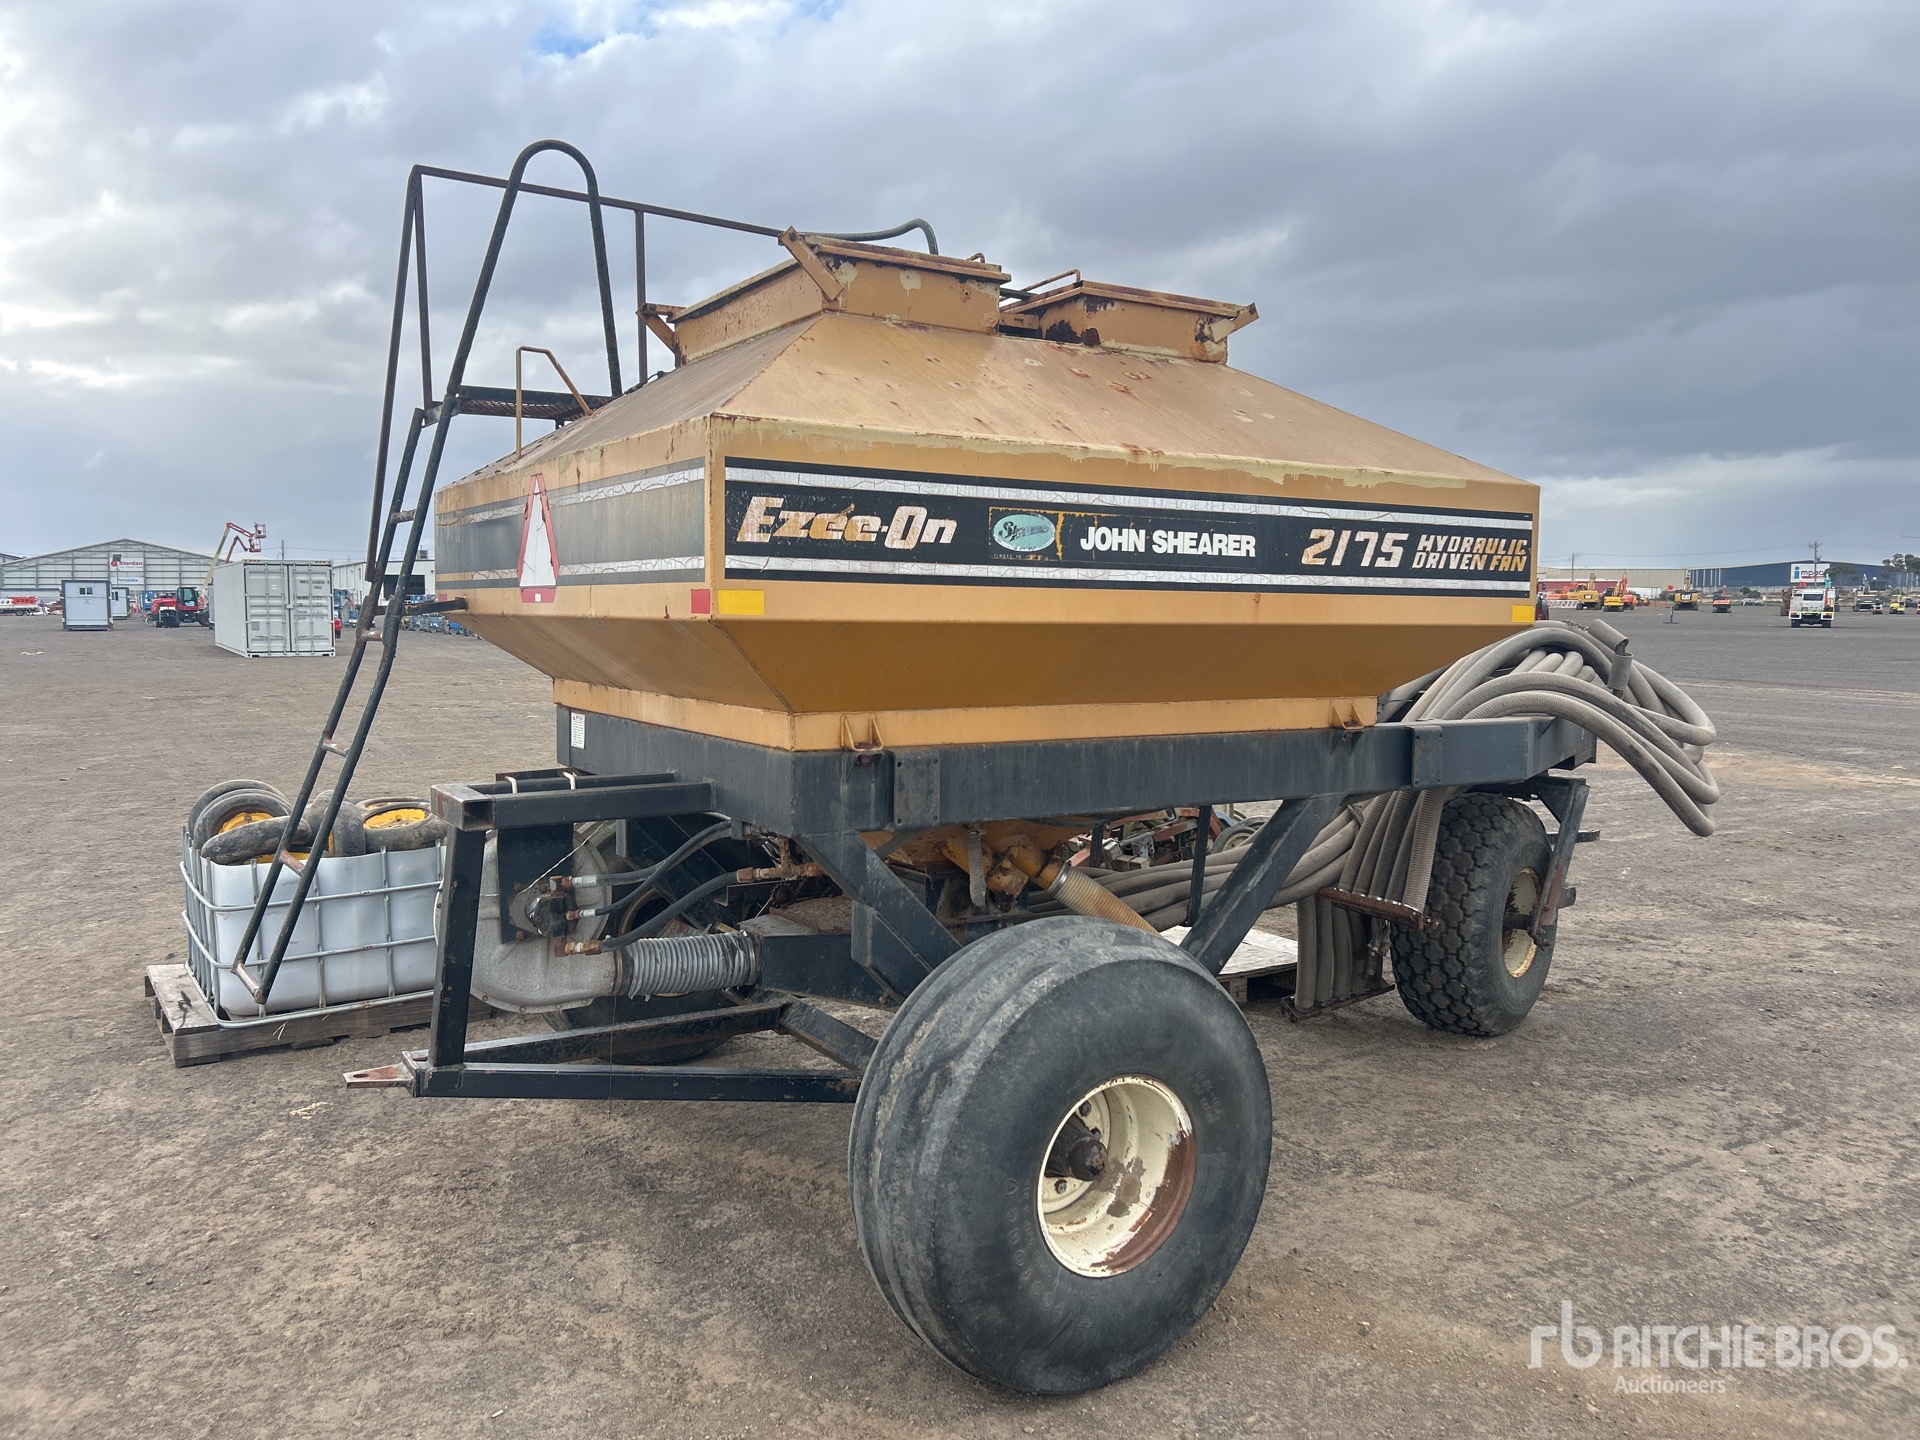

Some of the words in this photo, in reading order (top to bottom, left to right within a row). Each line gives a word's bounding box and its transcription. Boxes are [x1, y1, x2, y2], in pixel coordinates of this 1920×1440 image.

[737, 496, 957, 550] Ezee-On
[1080, 525, 1146, 552] JOHN
[1152, 529, 1256, 557] SHEARER
[1301, 528, 1409, 568] 2175
[1417, 534, 1528, 557] HYDRAULIC
[1412, 551, 1493, 571] DRIVEN
[1489, 553, 1527, 573] FAN
